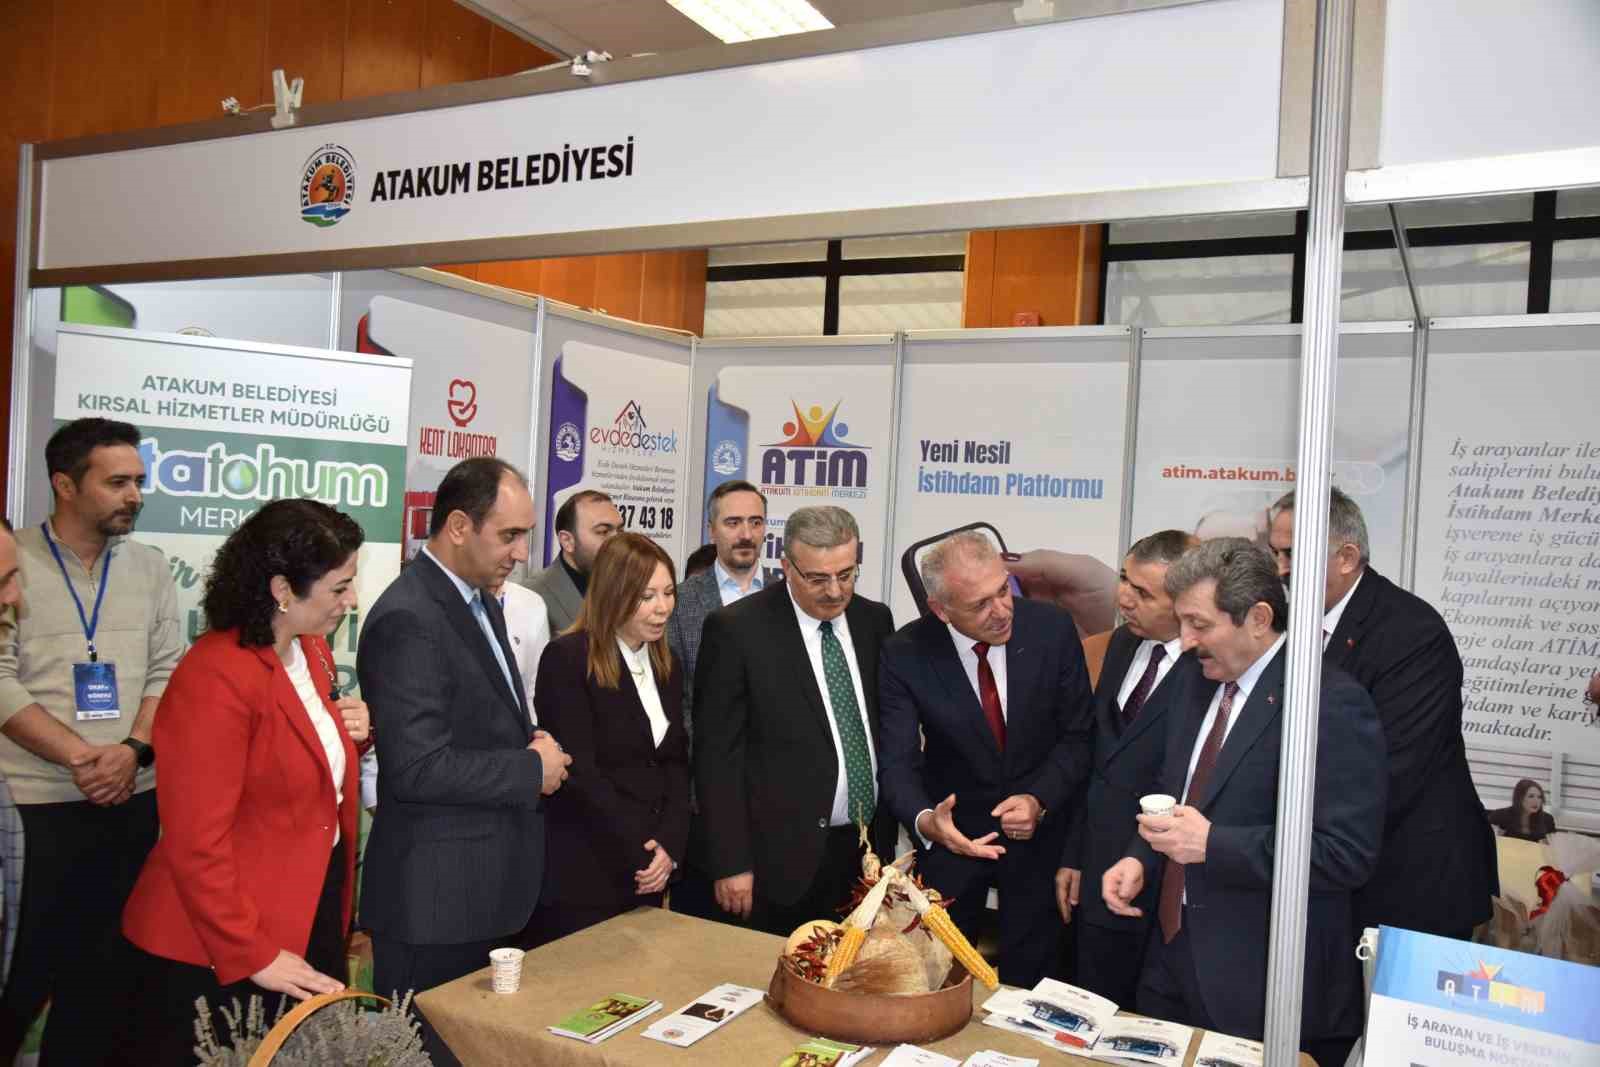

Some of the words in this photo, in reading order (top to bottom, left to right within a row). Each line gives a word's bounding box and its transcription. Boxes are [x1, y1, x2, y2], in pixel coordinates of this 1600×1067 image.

[370, 161, 471, 202] ATAKUM
[477, 136, 634, 192] BELEDİYESİ
[142, 375, 225, 396] ATAKUM
[232, 383, 337, 407] BELEDİYESİ
[78, 393, 150, 414] KIRSAL
[157, 397, 265, 423] HİZMETLER
[270, 408, 391, 434] MÜDÜRLÜĞÜ
[920, 440, 959, 463] Yeni
[964, 440, 1011, 464] Nesil
[1451, 438, 1467, 459] İş
[1473, 442, 1570, 461] arayanlar
[918, 466, 1000, 495] İstihdam
[1006, 473, 1103, 499] Platformu
[1449, 461, 1552, 481] sahiplerini
[1448, 483, 1525, 499] Atakum
[640, 506, 656, 529] 43
[661, 507, 674, 529] 18
[1448, 500, 1532, 521] İstihdam
[1445, 525, 1522, 543] işverene
[1529, 529, 1544, 546] iş
[1464, 550, 1573, 567] arayanlara
[1441, 566, 1582, 590] hayallerindeki
[1440, 586, 1533, 608] kapılarını
[1442, 608, 1533, 629] Ekonomik
[1540, 620, 1562, 631] ve
[1491, 634, 1534, 650] olan
[1521, 705, 1542, 717] ve
[1407, 1012, 1418, 1029] İŞ
[1422, 1018, 1473, 1040] ARAYAN
[1424, 1034, 1486, 1059] BULUŞMA
